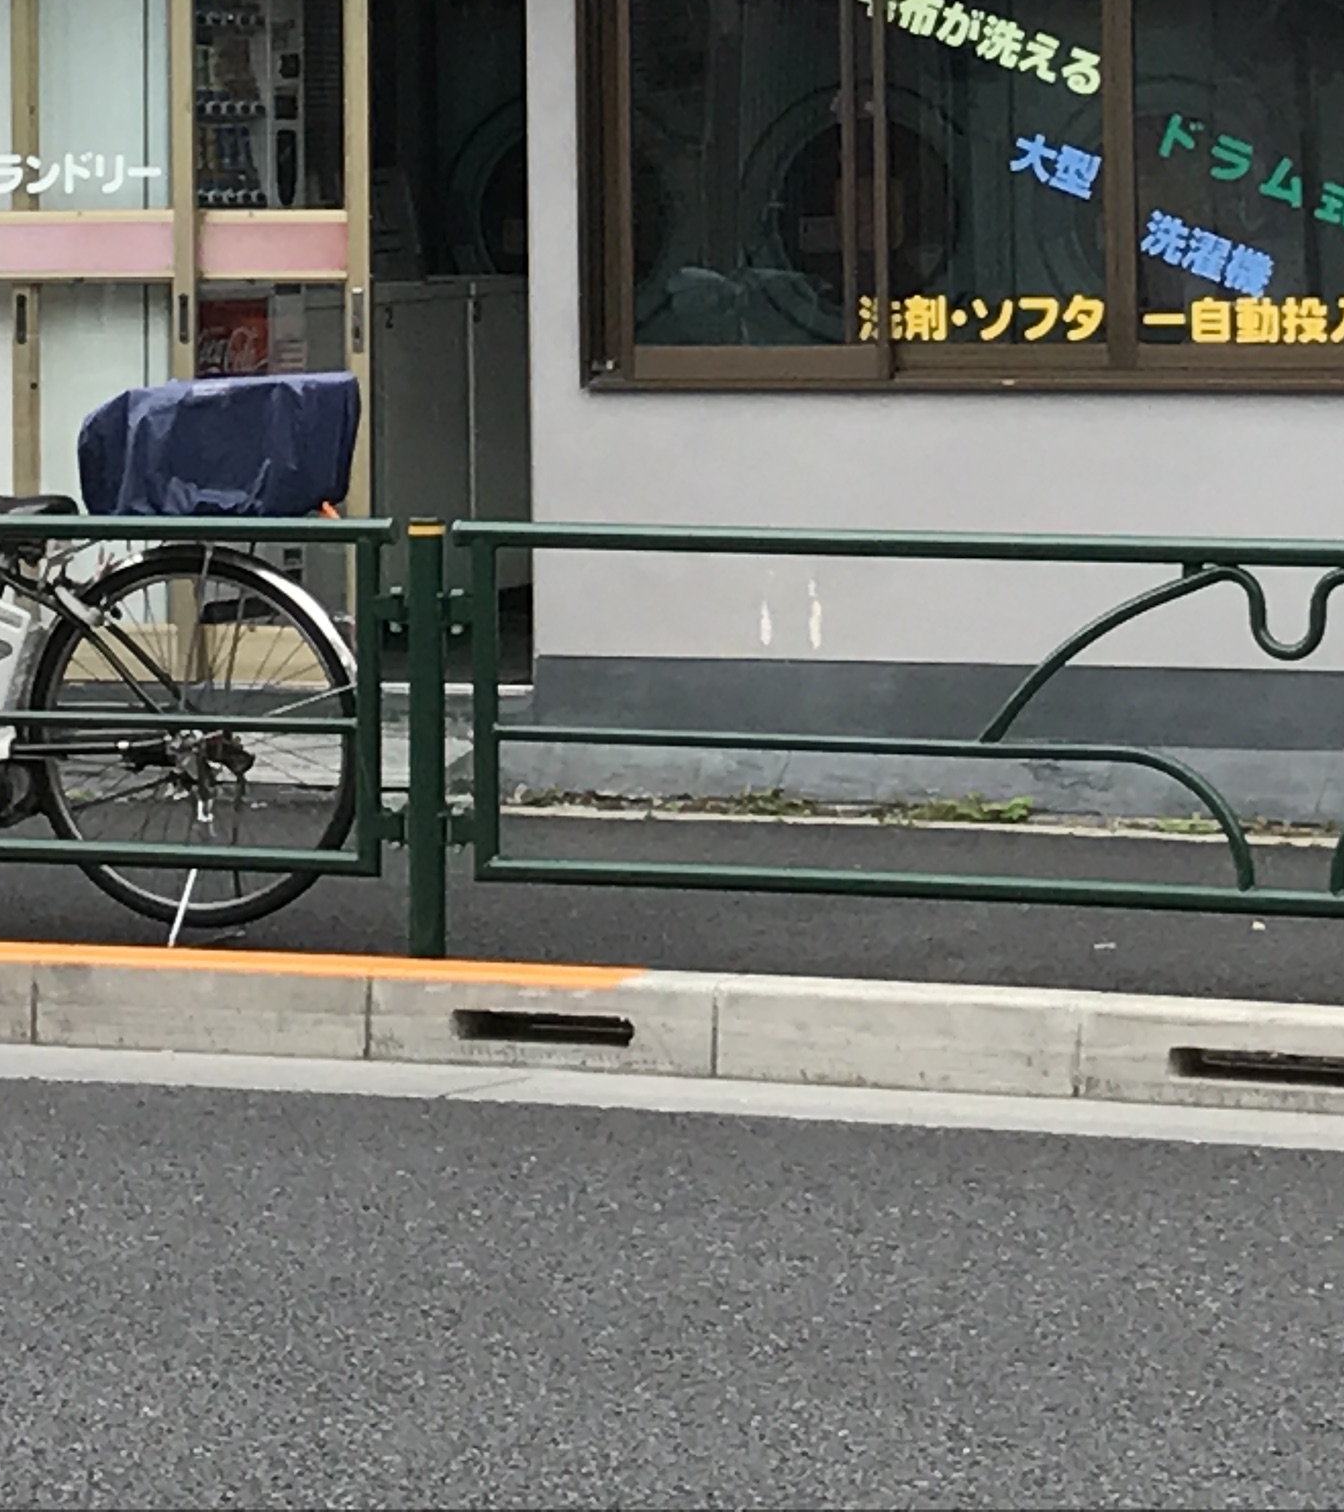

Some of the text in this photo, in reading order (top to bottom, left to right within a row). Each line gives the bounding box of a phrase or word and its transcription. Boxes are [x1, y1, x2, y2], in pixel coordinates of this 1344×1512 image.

[1010, 133, 1274, 298] 大型 洗濯機
